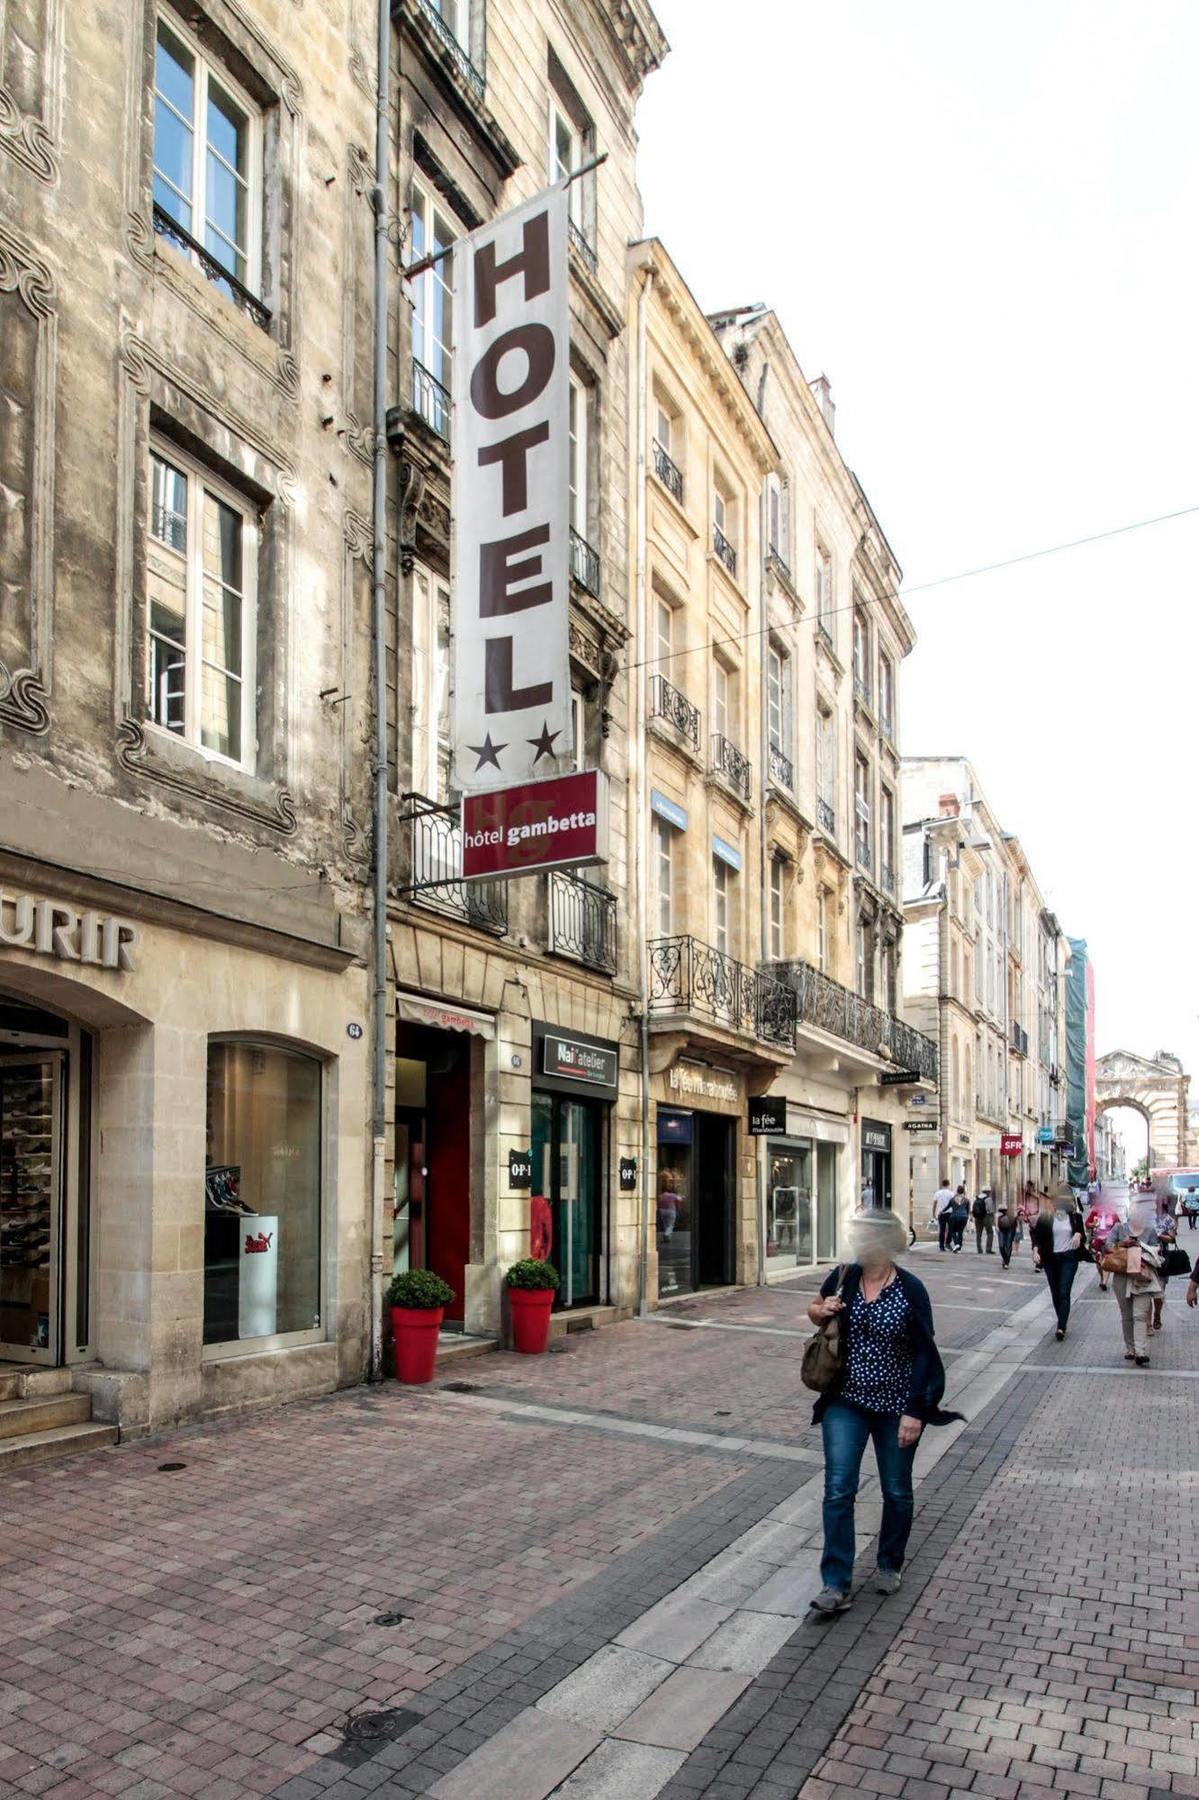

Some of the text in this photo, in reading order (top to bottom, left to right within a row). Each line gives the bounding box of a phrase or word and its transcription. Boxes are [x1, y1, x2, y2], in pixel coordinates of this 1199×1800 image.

[470, 211, 556, 715] HOTEL
[464, 811, 596, 848] hôtel gambetta
[752, 1113, 776, 1128] la fée
[1005, 1141, 1021, 1150] SFR
